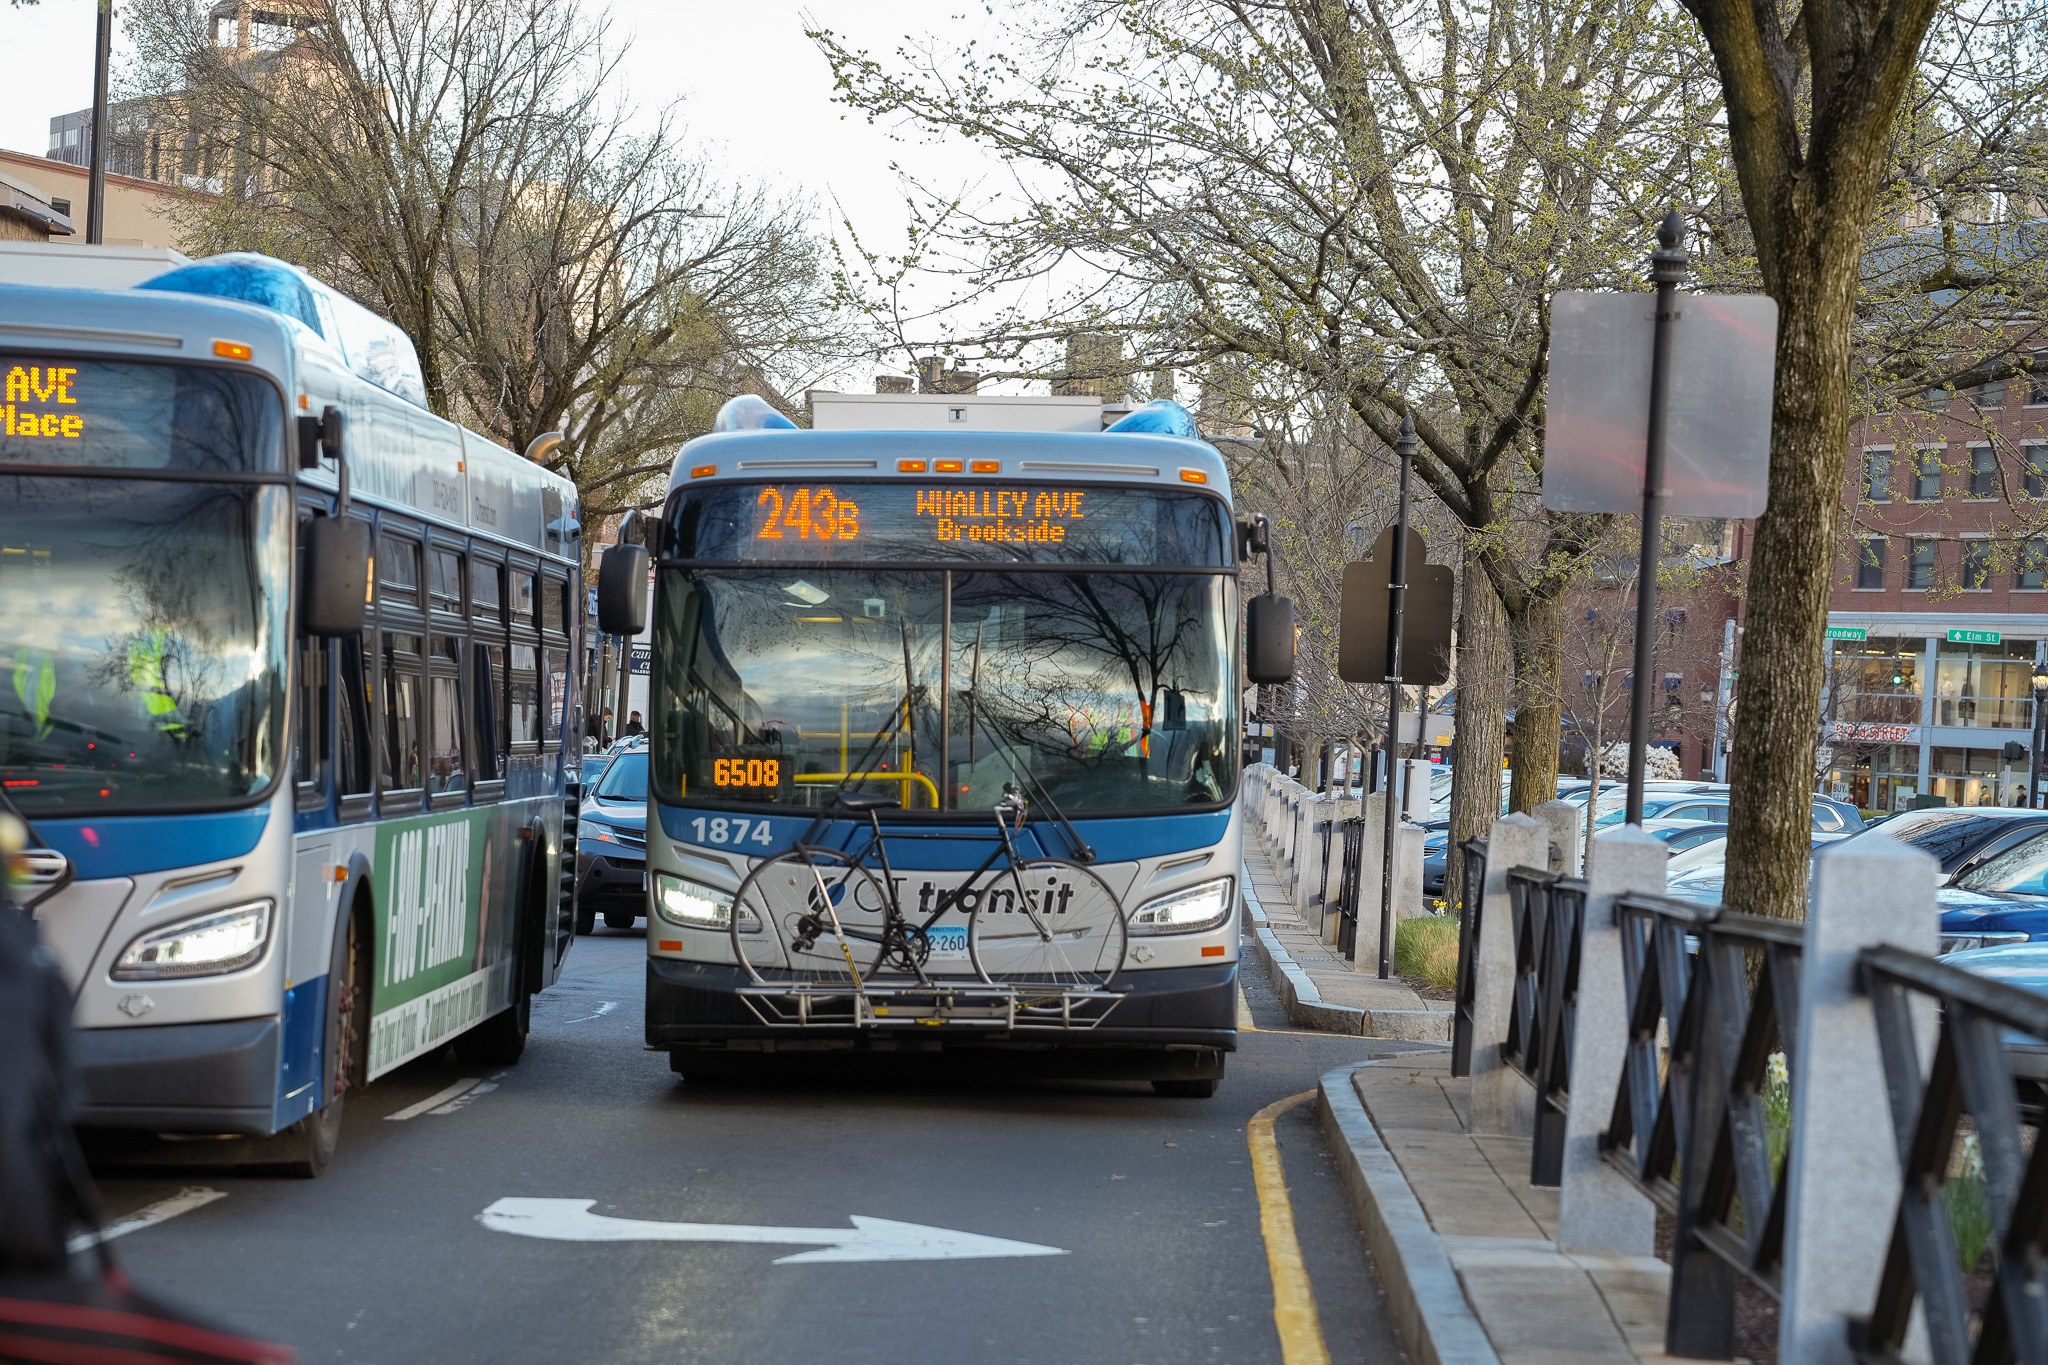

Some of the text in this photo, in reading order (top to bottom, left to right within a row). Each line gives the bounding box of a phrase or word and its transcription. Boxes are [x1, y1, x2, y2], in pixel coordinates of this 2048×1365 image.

[6, 366, 77, 404] AVE
[917, 490, 1084, 517] WHALLEY AVE
[938, 518, 1065, 542] Brookside
[1966, 631, 1996, 642] Elm St
[1847, 725, 1908, 740] 2nd STREET
[714, 758, 779, 787] 6508
[691, 817, 773, 845] 1874
[919, 876, 1074, 914] transit
